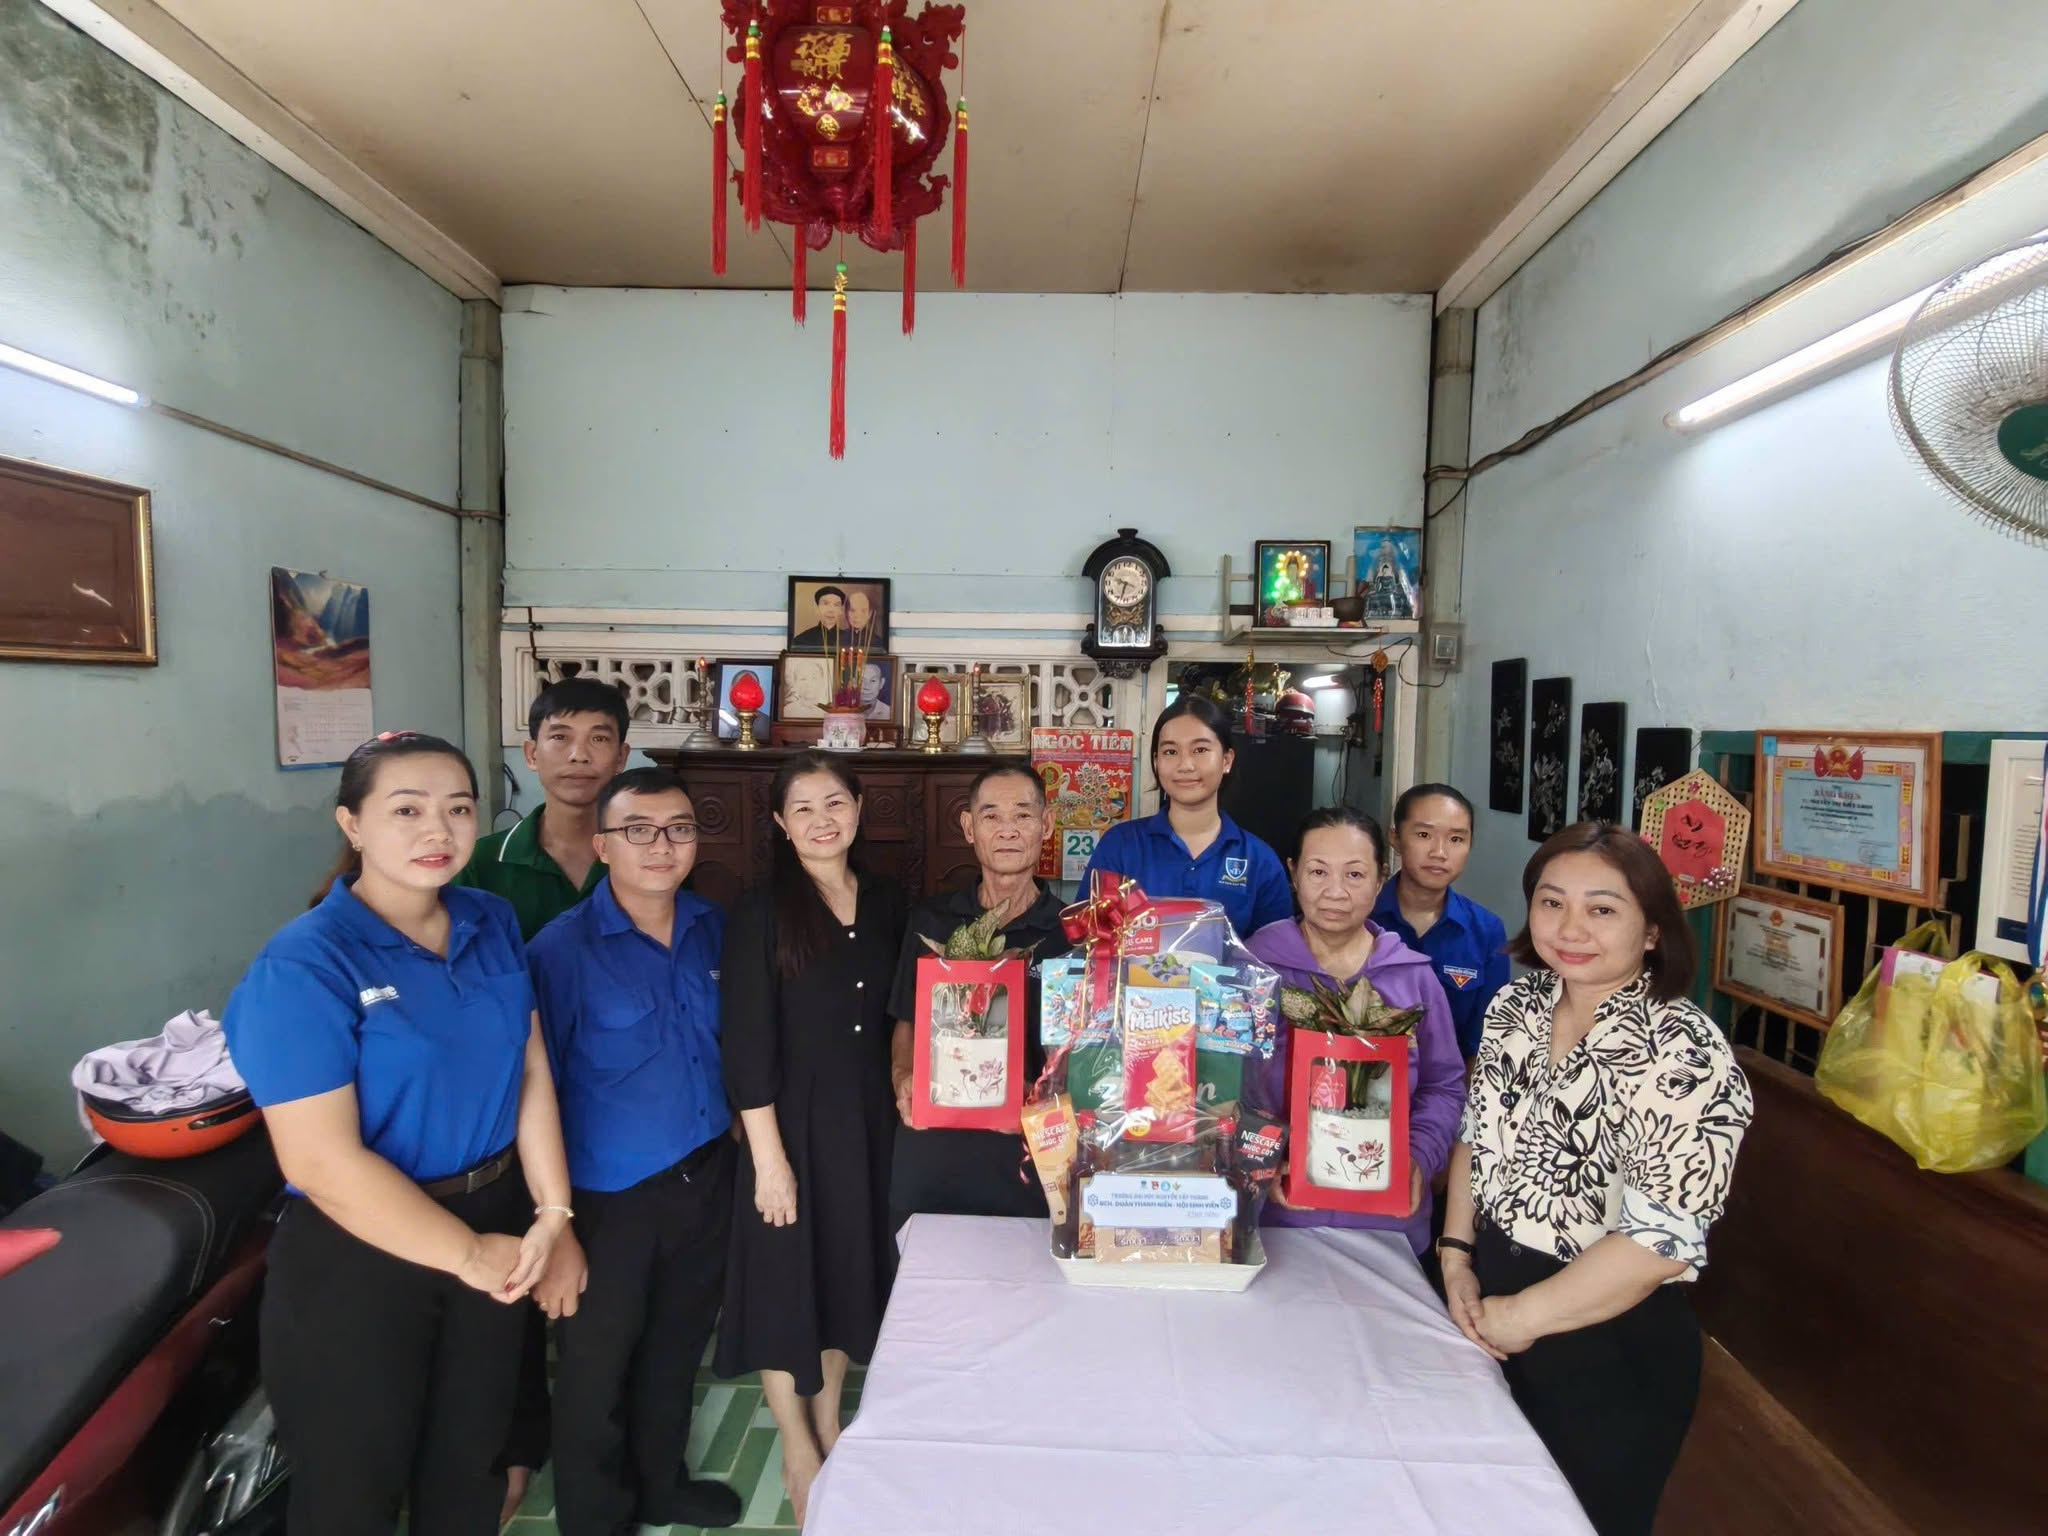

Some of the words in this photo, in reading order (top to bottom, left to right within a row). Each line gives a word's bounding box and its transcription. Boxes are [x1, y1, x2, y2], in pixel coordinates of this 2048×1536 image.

[1034, 735, 1084, 753] NGỌC
[1090, 732, 1132, 751] TIÊN
[1067, 835, 1095, 856] 23
[1129, 1004, 1191, 1032] Malkist
